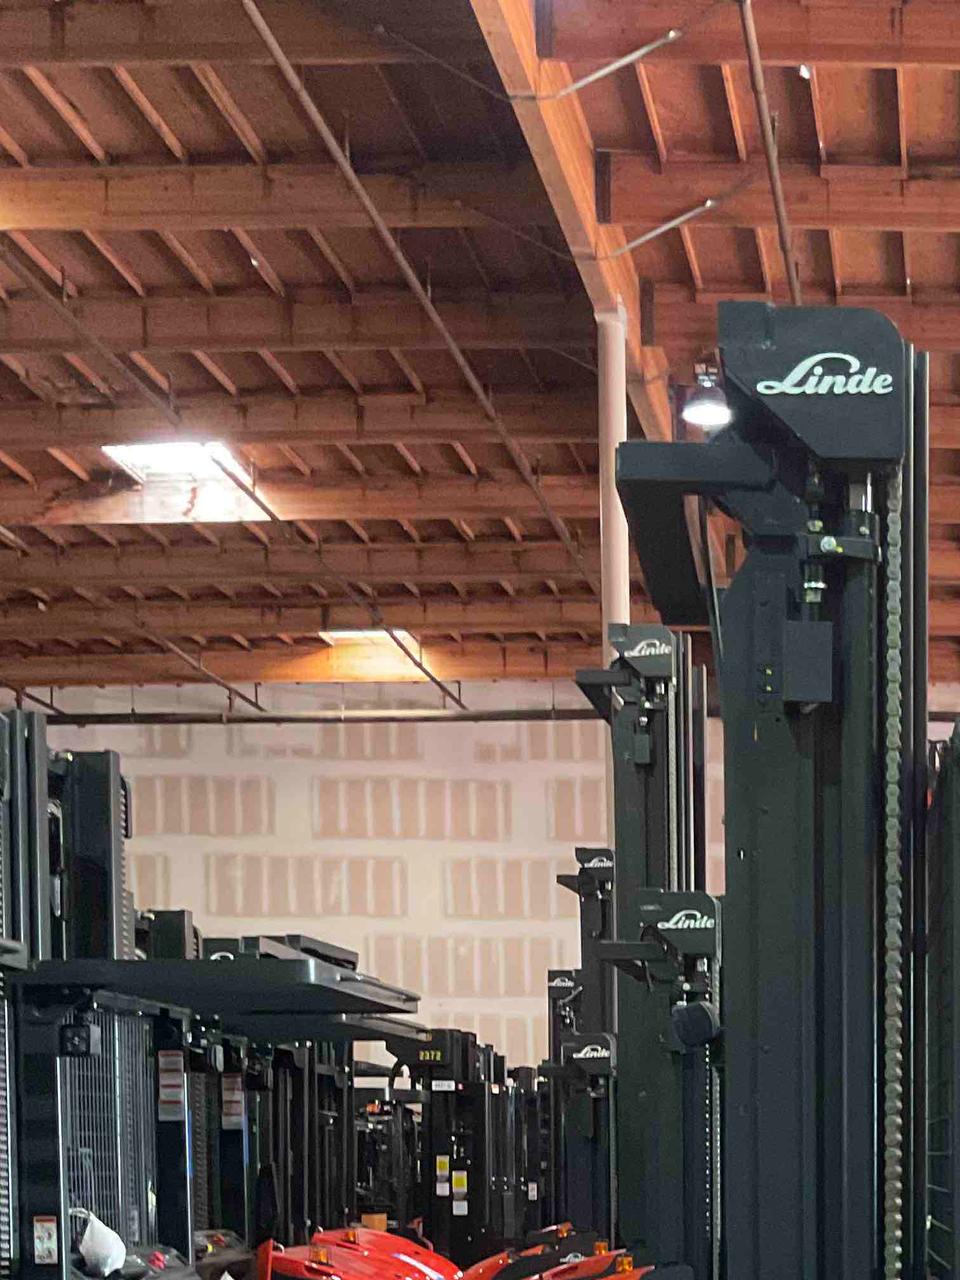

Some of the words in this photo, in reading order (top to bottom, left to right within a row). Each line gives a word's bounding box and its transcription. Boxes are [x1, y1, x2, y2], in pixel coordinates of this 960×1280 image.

[756, 352, 893, 395] Linde
[623, 639, 672, 657] Linde
[584, 856, 613, 868] Linde
[657, 909, 715, 929] Linde
[572, 1044, 611, 1059] Linde
